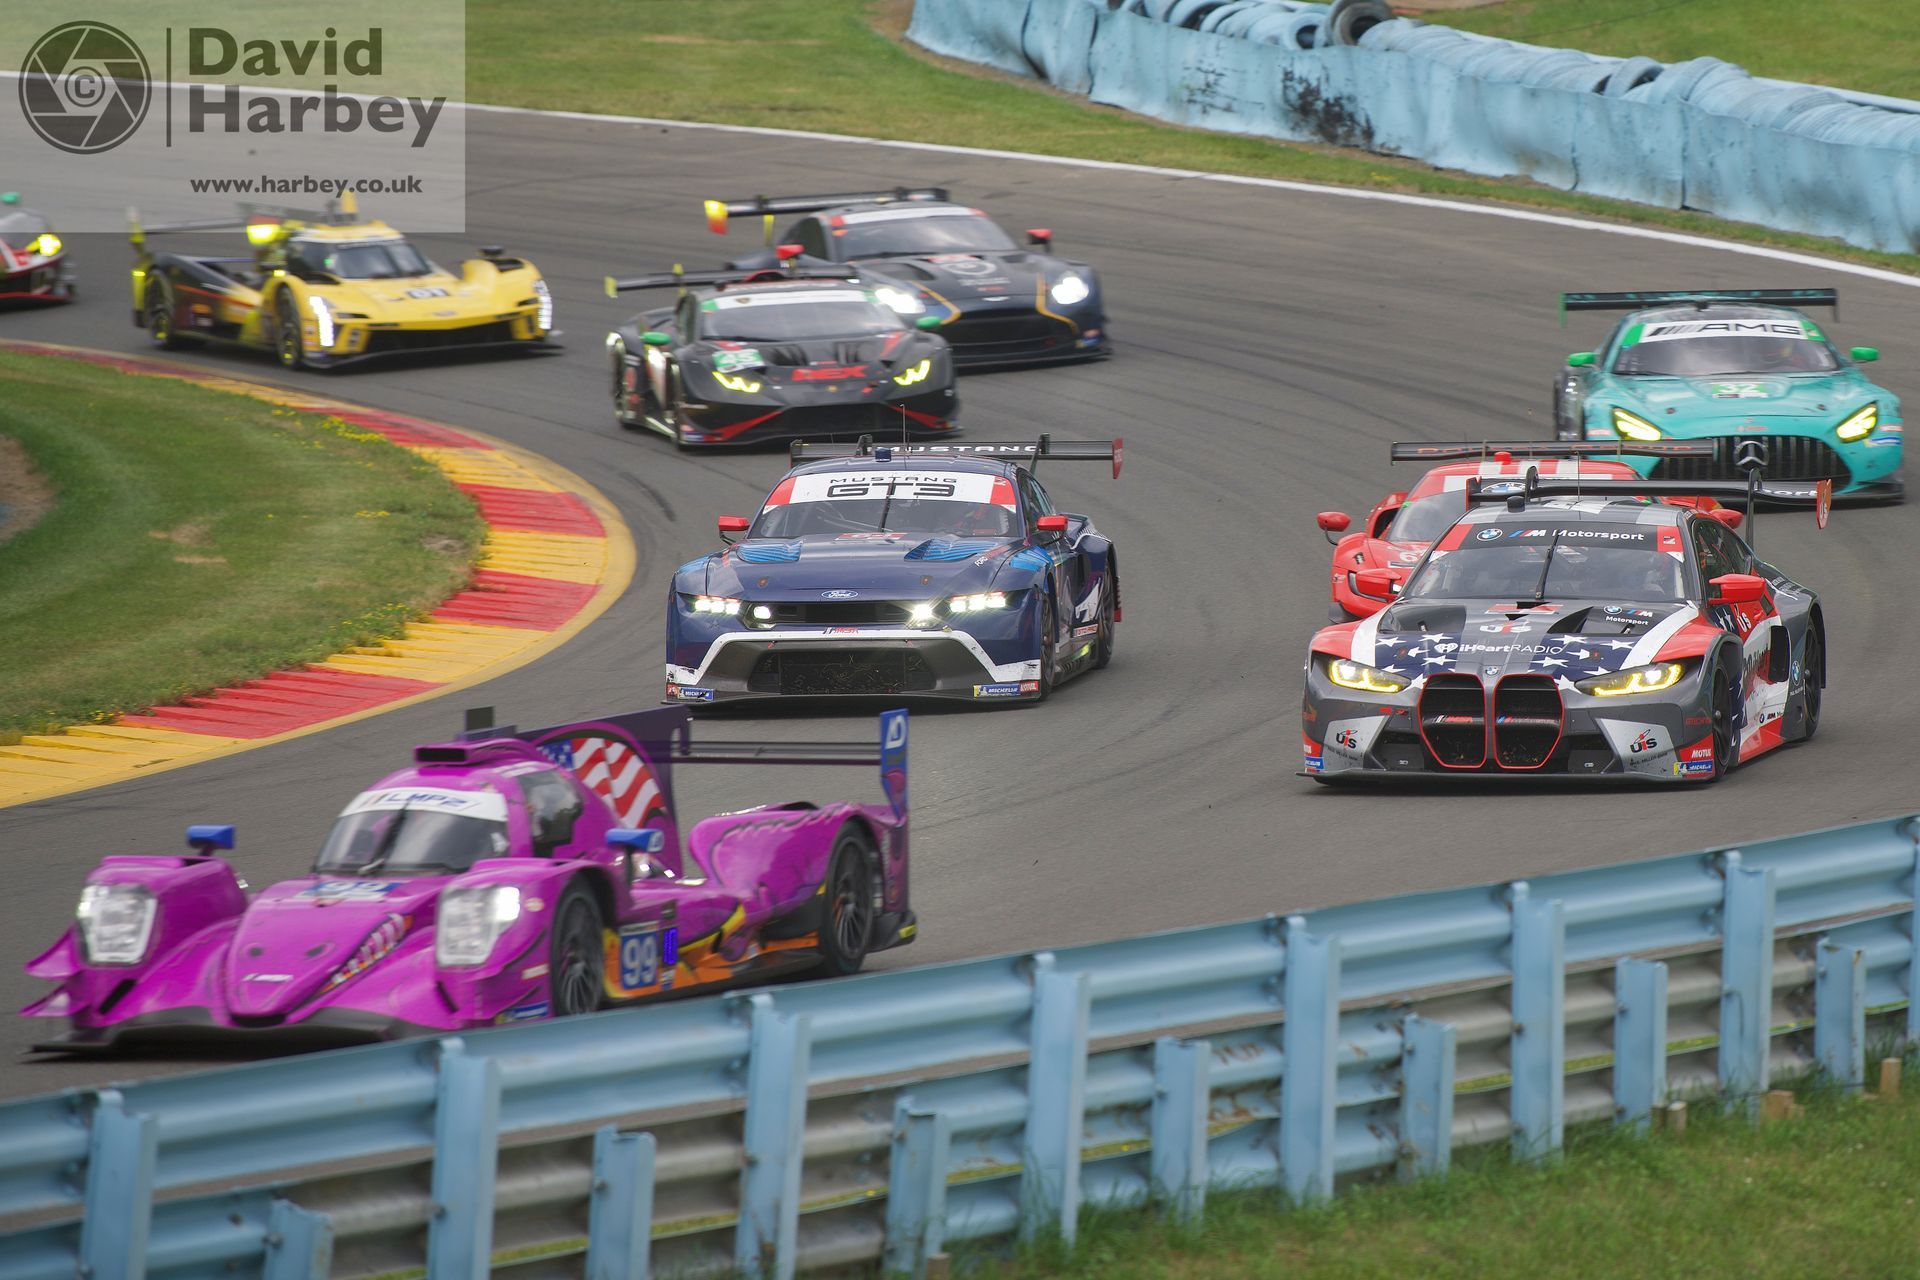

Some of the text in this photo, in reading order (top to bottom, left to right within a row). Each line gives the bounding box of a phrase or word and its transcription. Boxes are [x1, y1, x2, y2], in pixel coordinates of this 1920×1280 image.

[1697, 323, 1801, 336] AMG
[1718, 383, 1758, 394] 32
[830, 476, 957, 484] MUSTANG
[827, 482, 956, 498] GT3
[1551, 529, 1645, 541] Motorsport
[1605, 616, 1650, 625] Motorsport
[1691, 748, 1712, 758] MOTUL
[623, 936, 657, 986] 99
